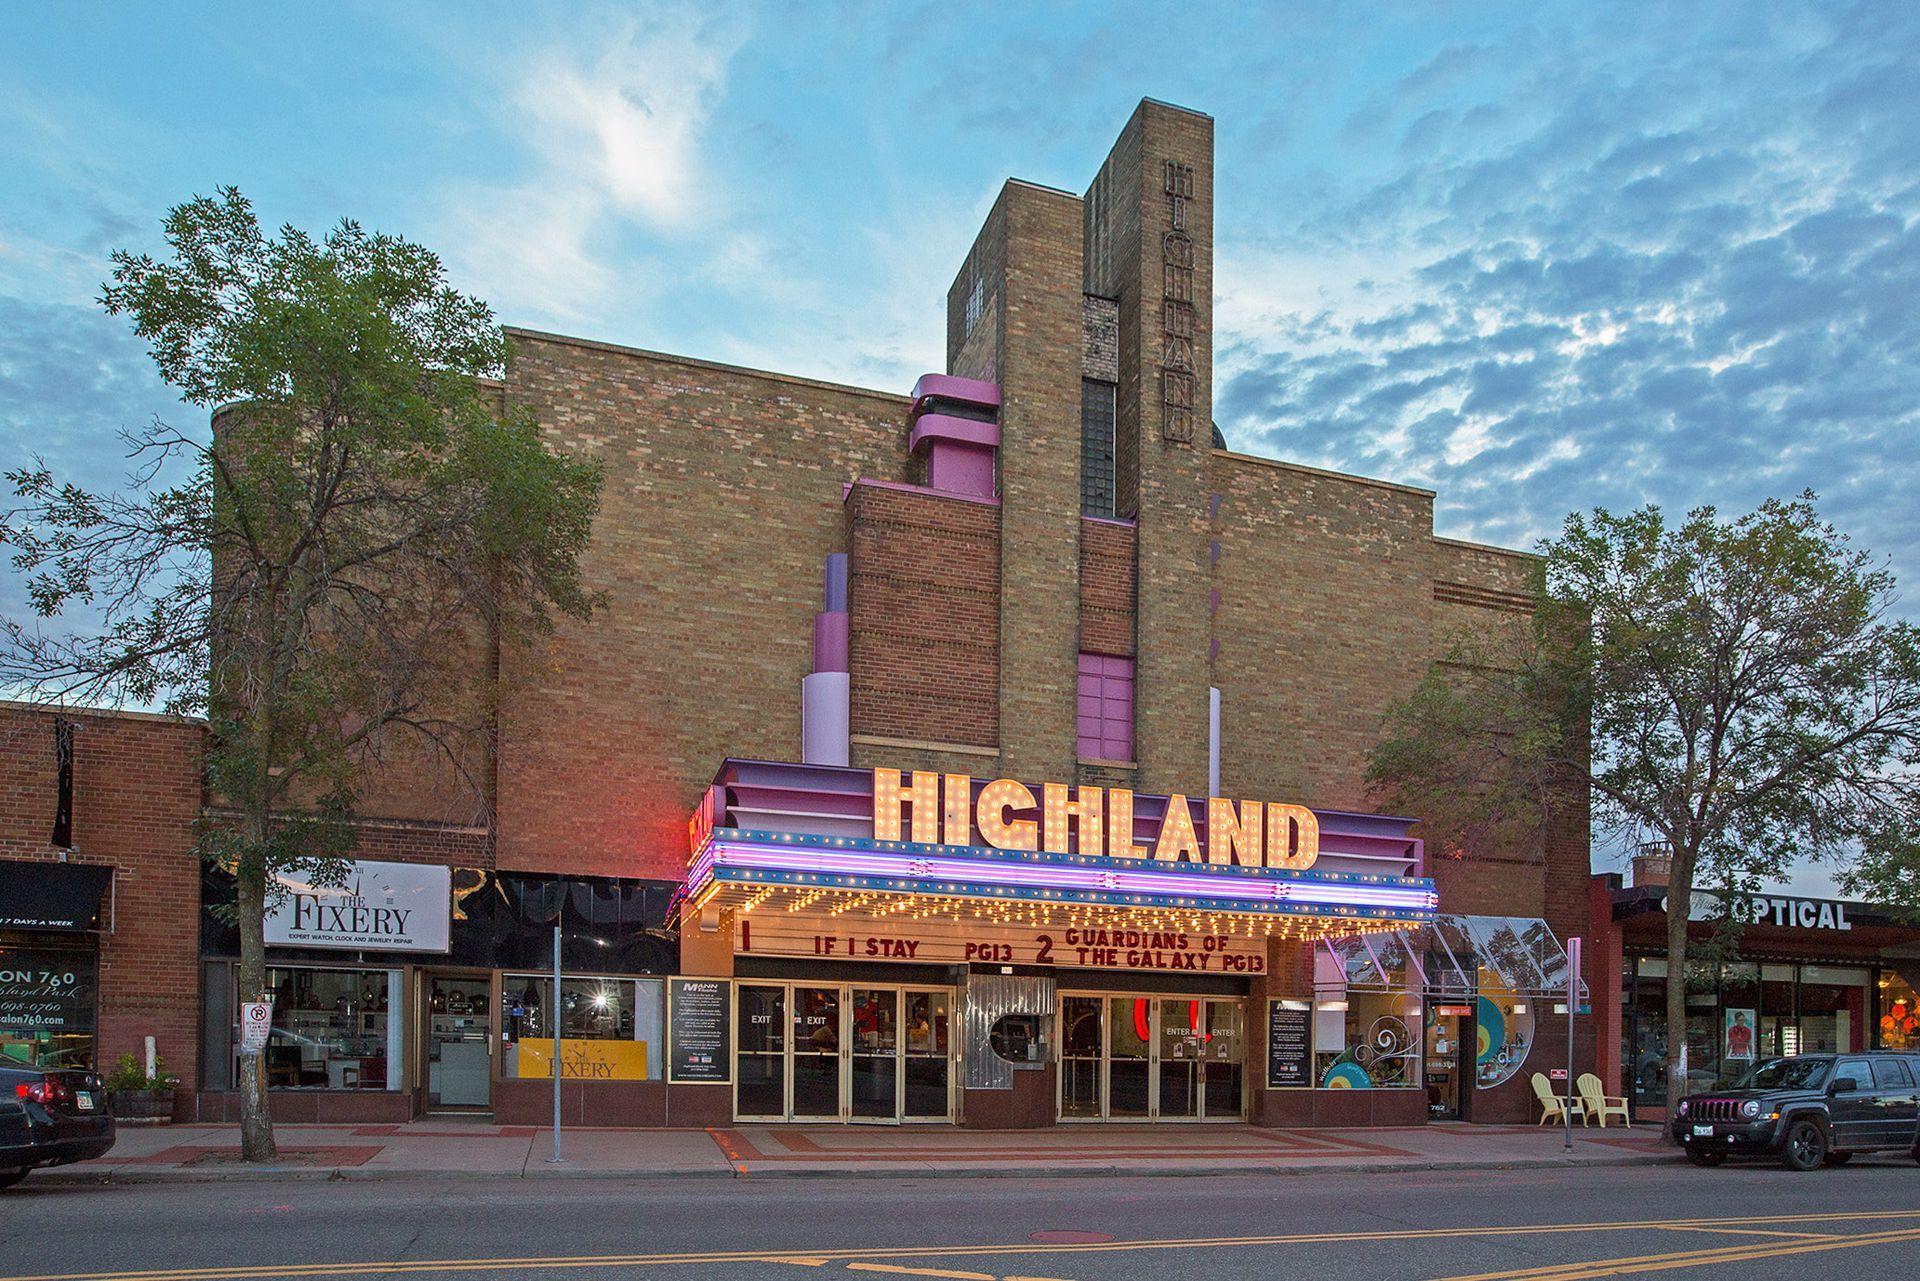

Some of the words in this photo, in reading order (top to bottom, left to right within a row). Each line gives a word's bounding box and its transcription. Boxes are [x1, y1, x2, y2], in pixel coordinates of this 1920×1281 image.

[1162, 159, 1198, 442] HIGHLAND
[873, 766, 1320, 870] HIGHLAND
[340, 896, 365, 907] THE
[290, 893, 412, 935] FIXERY
[1730, 896, 1851, 930] OPTICAL
[815, 936, 837, 954] IF
[849, 937, 855, 955] I
[865, 937, 920, 958] STAY
[965, 943, 1012, 961] PG13
[1036, 934, 1054, 963] 2
[1065, 928, 1189, 950] GUARDIANS
[1203, 935, 1229, 952] OF
[1076, 947, 1118, 965] THE
[1127, 950, 1210, 970] GALAXY
[1222, 955, 1265, 972] PG13
[39, 971, 75, 987] 760
[683, 982, 718, 992] MANN
[0, 1013, 64, 1025] alon760.com
[751, 1015, 771, 1024] EXIT
[807, 1016, 826, 1025] EXIT
[1166, 1028, 1190, 1036] ENTER
[1212, 1029, 1235, 1037] ENTER
